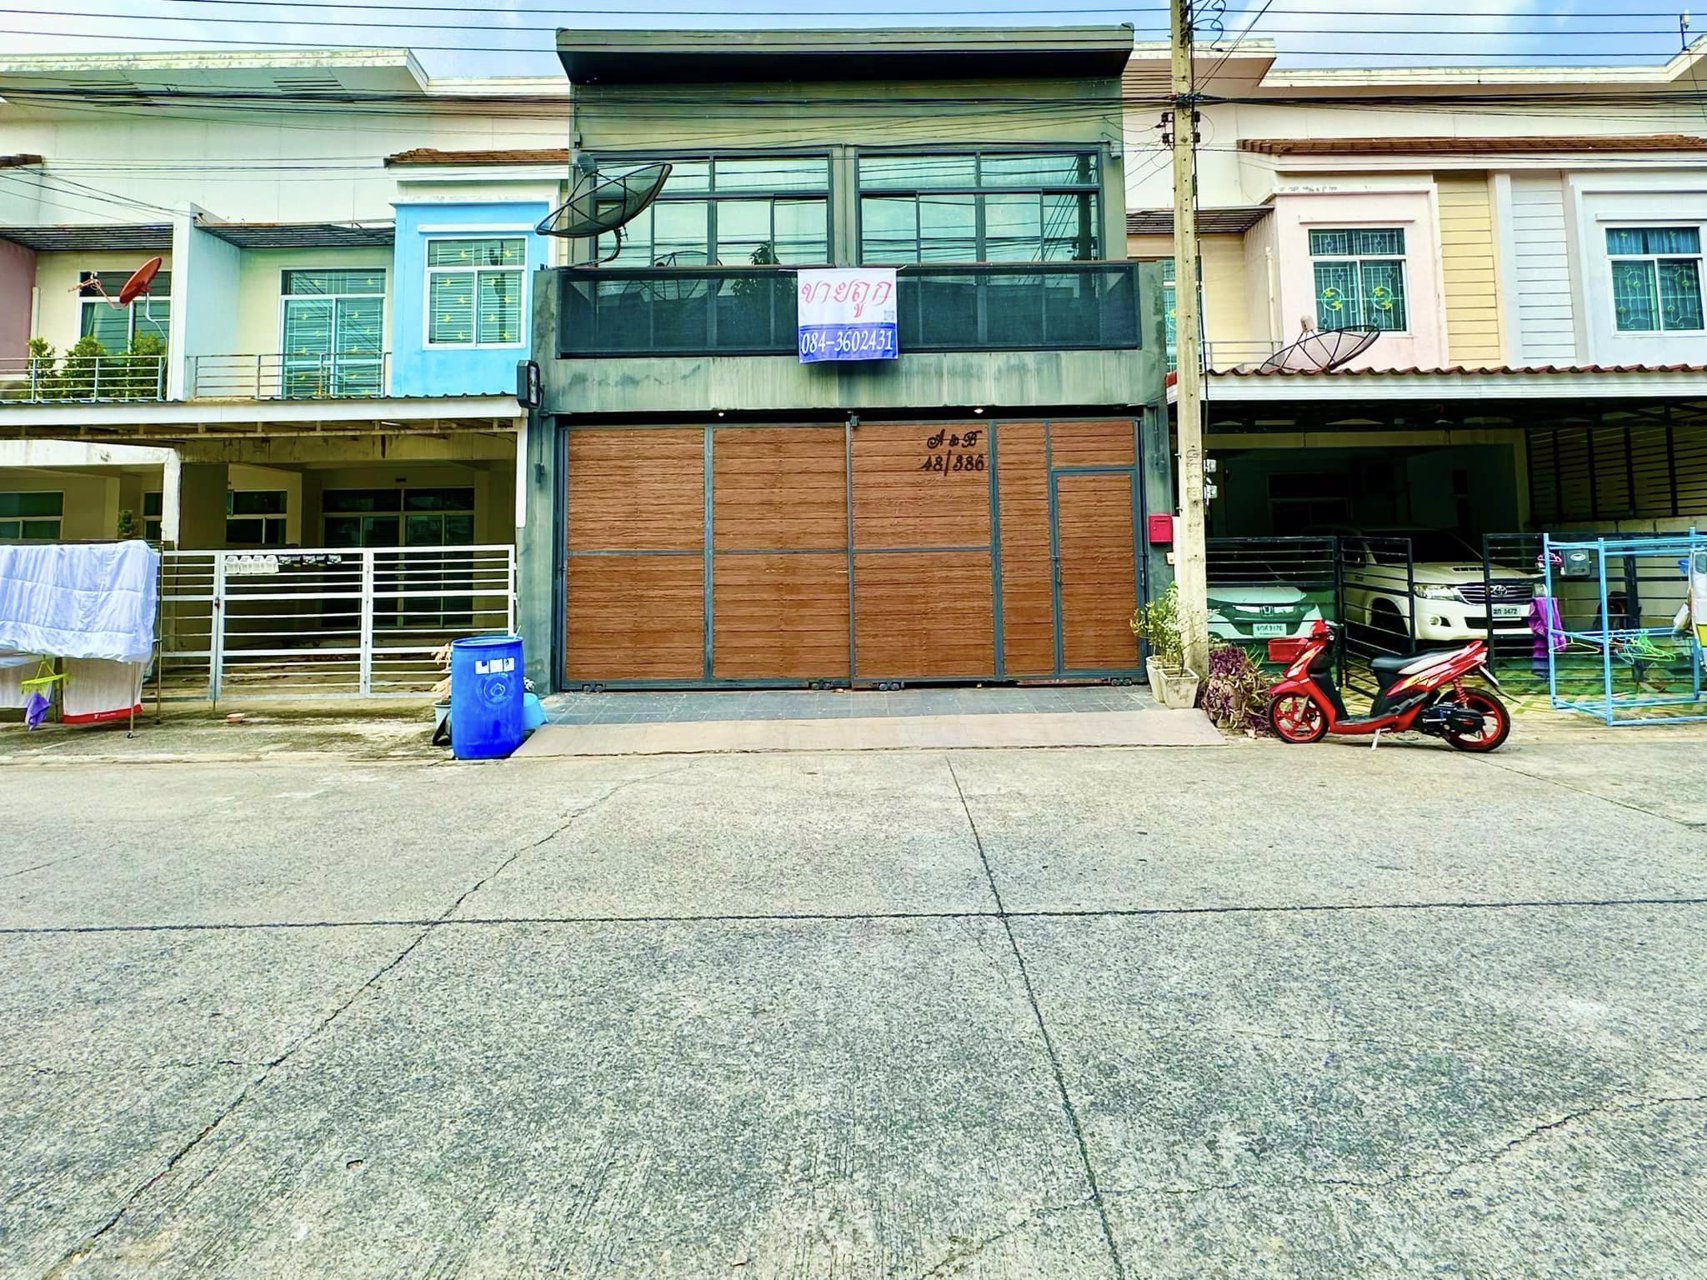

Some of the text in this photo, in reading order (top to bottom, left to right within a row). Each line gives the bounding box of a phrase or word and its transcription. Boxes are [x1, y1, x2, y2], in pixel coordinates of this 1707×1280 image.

[801, 279, 892, 319] ขายถูก
[801, 330, 893, 355] 084-3602431
